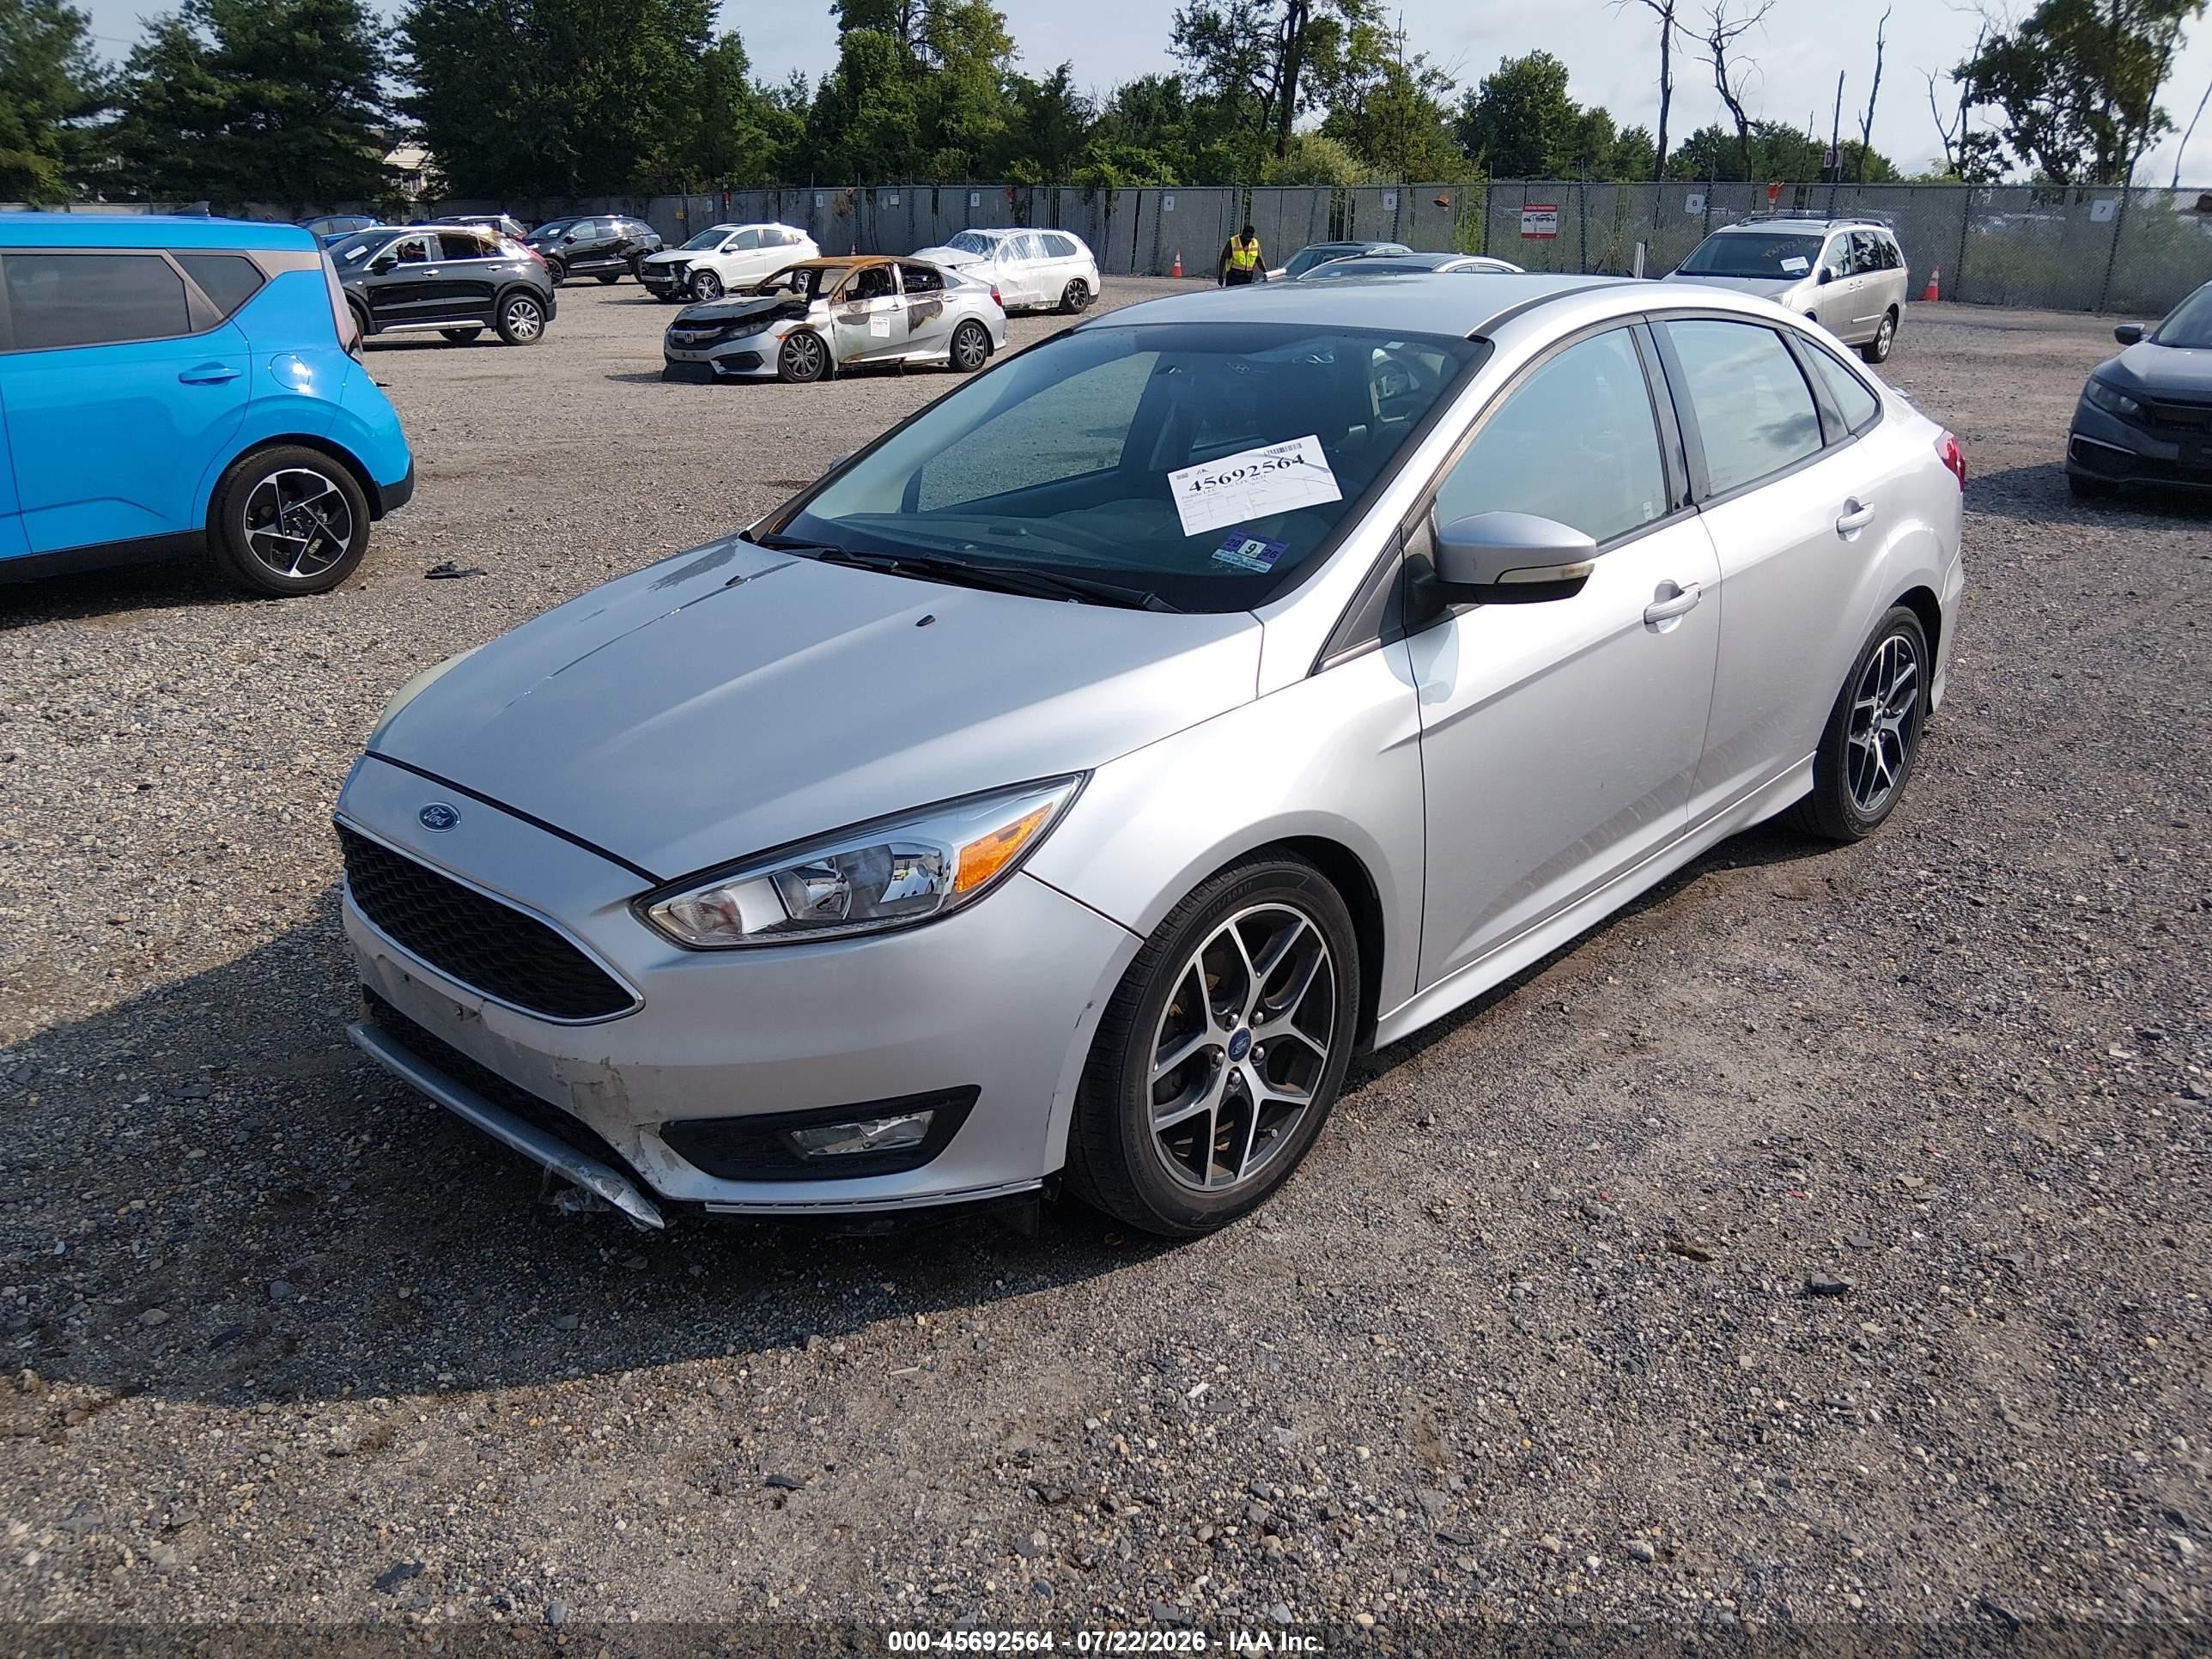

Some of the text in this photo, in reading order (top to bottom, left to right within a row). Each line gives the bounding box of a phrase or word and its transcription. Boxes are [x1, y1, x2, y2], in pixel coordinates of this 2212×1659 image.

[1188, 454, 1305, 492] 45692564
[1226, 538, 1242, 548] 20
[1244, 543, 1258, 555] 9
[1262, 549, 1279, 559] 26
[423, 806, 451, 826] Ford
